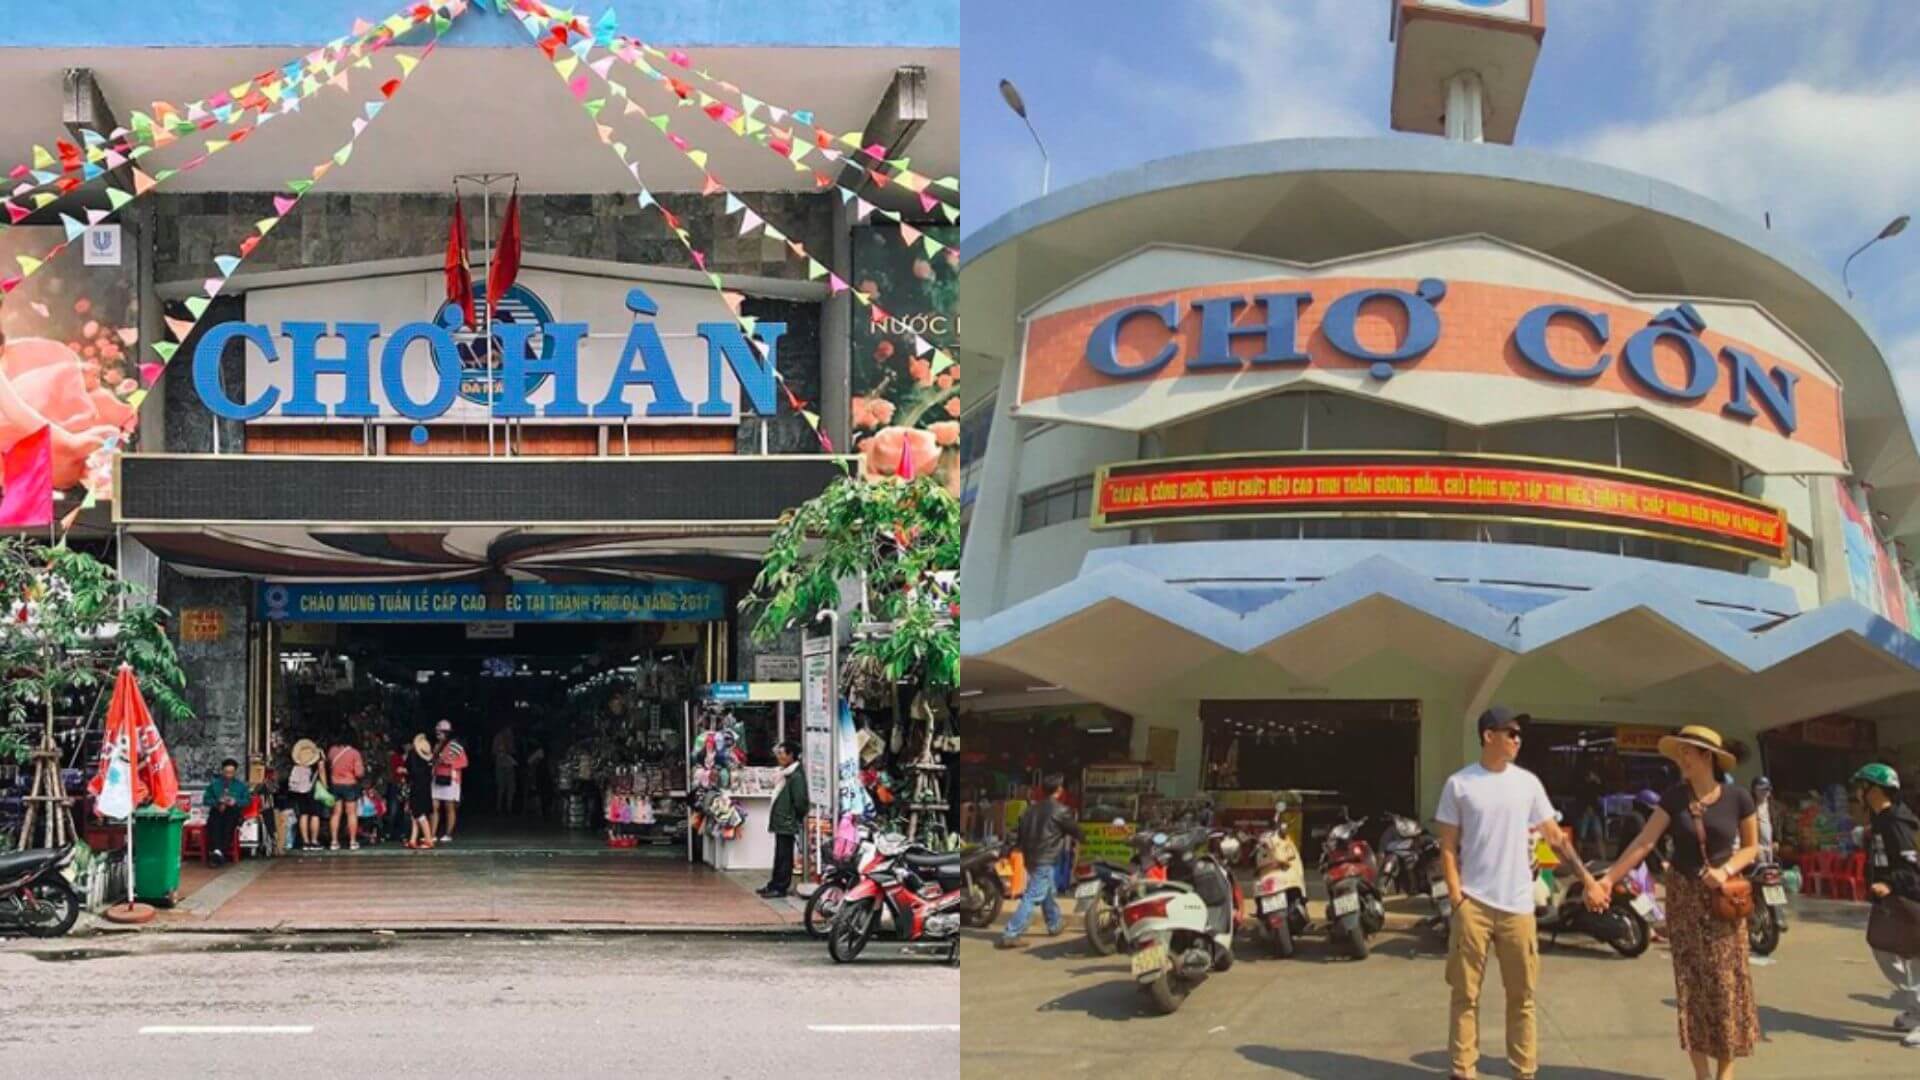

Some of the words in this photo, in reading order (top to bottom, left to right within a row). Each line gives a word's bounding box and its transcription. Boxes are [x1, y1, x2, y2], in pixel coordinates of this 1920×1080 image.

[192, 303, 464, 445] CHỢ
[492, 288, 787, 417] HÀN
[1086, 277, 1447, 380] CHỢ
[1515, 302, 1800, 436] CỒN
[1292, 477, 1313, 495] CAO
[300, 590, 335, 612] CHÀO
[337, 590, 375, 612] MỪNG
[379, 588, 411, 612] TUẦN
[461, 594, 486, 612] CAO
